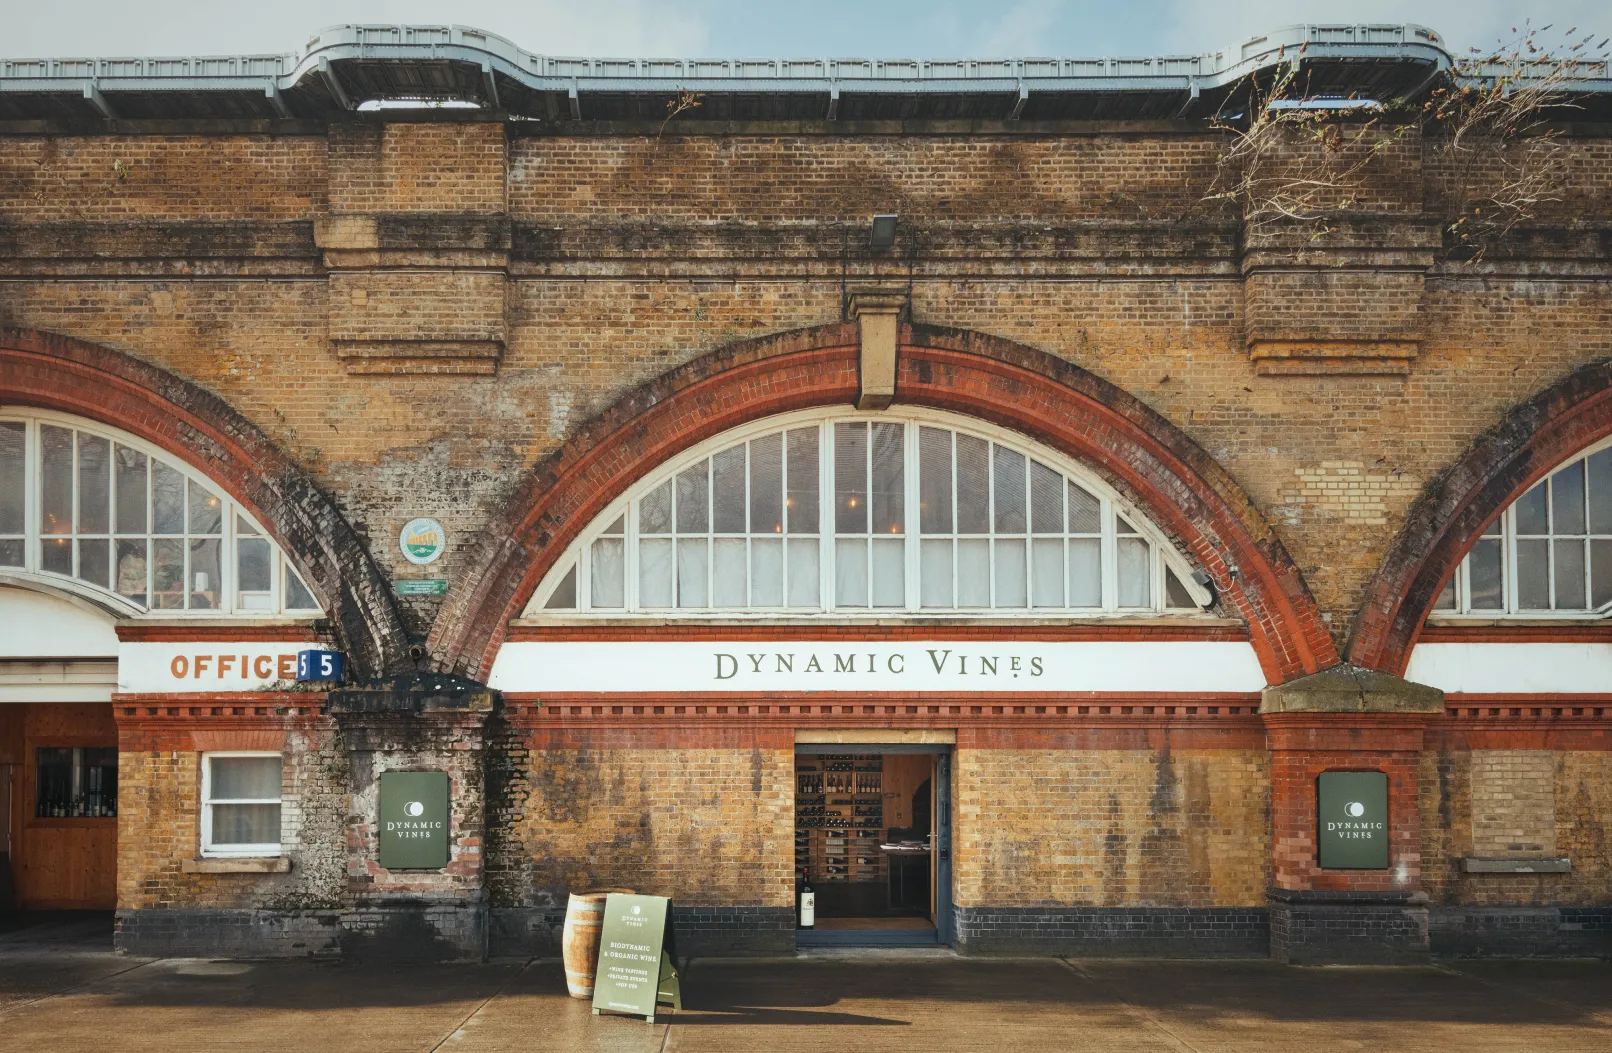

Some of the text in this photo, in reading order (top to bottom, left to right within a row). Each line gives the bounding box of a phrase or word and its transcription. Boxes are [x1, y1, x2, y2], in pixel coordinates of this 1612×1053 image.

[170, 654, 297, 679] OFFICE
[300, 654, 307, 676] 5
[320, 654, 333, 676] 5
[713, 649, 1044, 680] DYNAMIC VINES
[386, 822, 441, 830] DYNAMIC
[1327, 822, 1382, 831] DYNAMIC
[1338, 831, 1372, 839] VINES
[610, 942, 650, 951] BIODYNAMIC
[609, 951, 639, 960] ORGANIC
[640, 954, 657, 962] WINE
